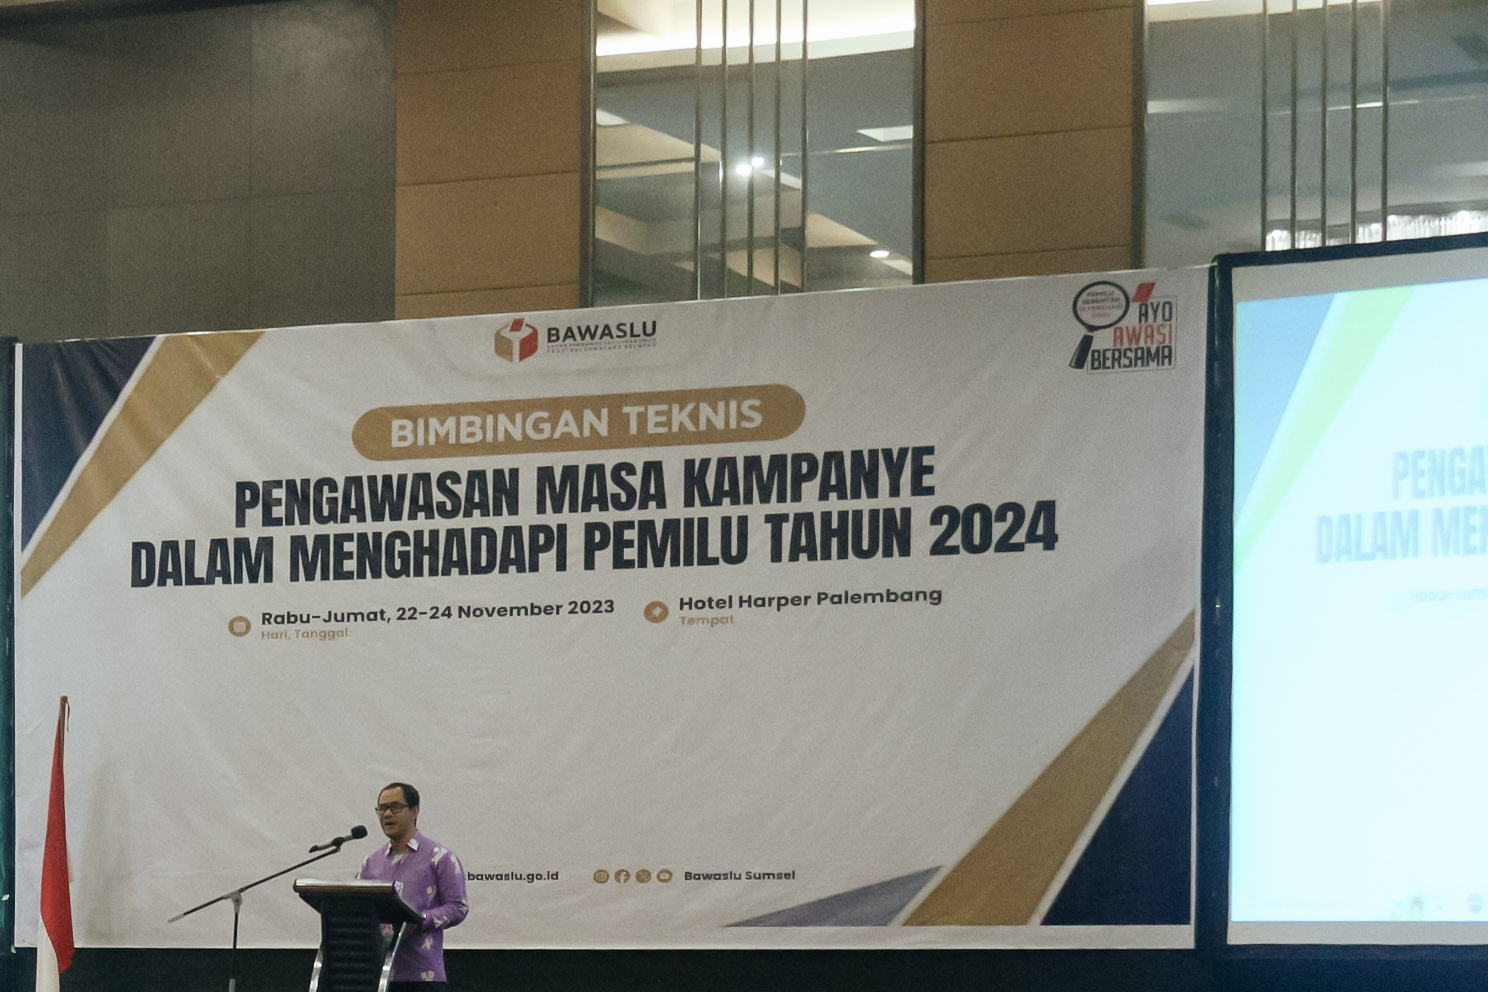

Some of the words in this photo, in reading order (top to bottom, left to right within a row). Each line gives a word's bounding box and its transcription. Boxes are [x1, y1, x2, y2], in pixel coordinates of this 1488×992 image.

[1138, 301, 1173, 324] AYO
[547, 320, 657, 343] BAWASLU
[1113, 324, 1173, 347] AWASI
[1090, 345, 1173, 370] BERSAMA
[391, 406, 609, 448] BIMBINGAN
[622, 399, 763, 435] TEKNIS
[235, 467, 520, 528] PENGAWASAN
[536, 460, 667, 515] MASA
[683, 446, 936, 507] KAMPANYE
[130, 536, 274, 588] DALAM
[289, 523, 568, 583] MENGHADAPI
[584, 515, 749, 571] PEMILU
[764, 507, 912, 562] TAHUN
[929, 500, 1058, 556] 2024
[1316, 509, 1420, 564] DALAM
[396, 606, 453, 621] 22-24
[458, 602, 564, 619] November
[567, 599, 615, 615] 2023
[679, 594, 733, 611] Hotel
[738, 593, 812, 612] Harper
[816, 588, 943, 606] Palembang
[680, 614, 734, 628] Tempat
[261, 629, 290, 641] Hari,
[295, 627, 348, 642] Tanggal
[684, 869, 742, 881] Bawaslu
[745, 869, 796, 881] Sumsel
